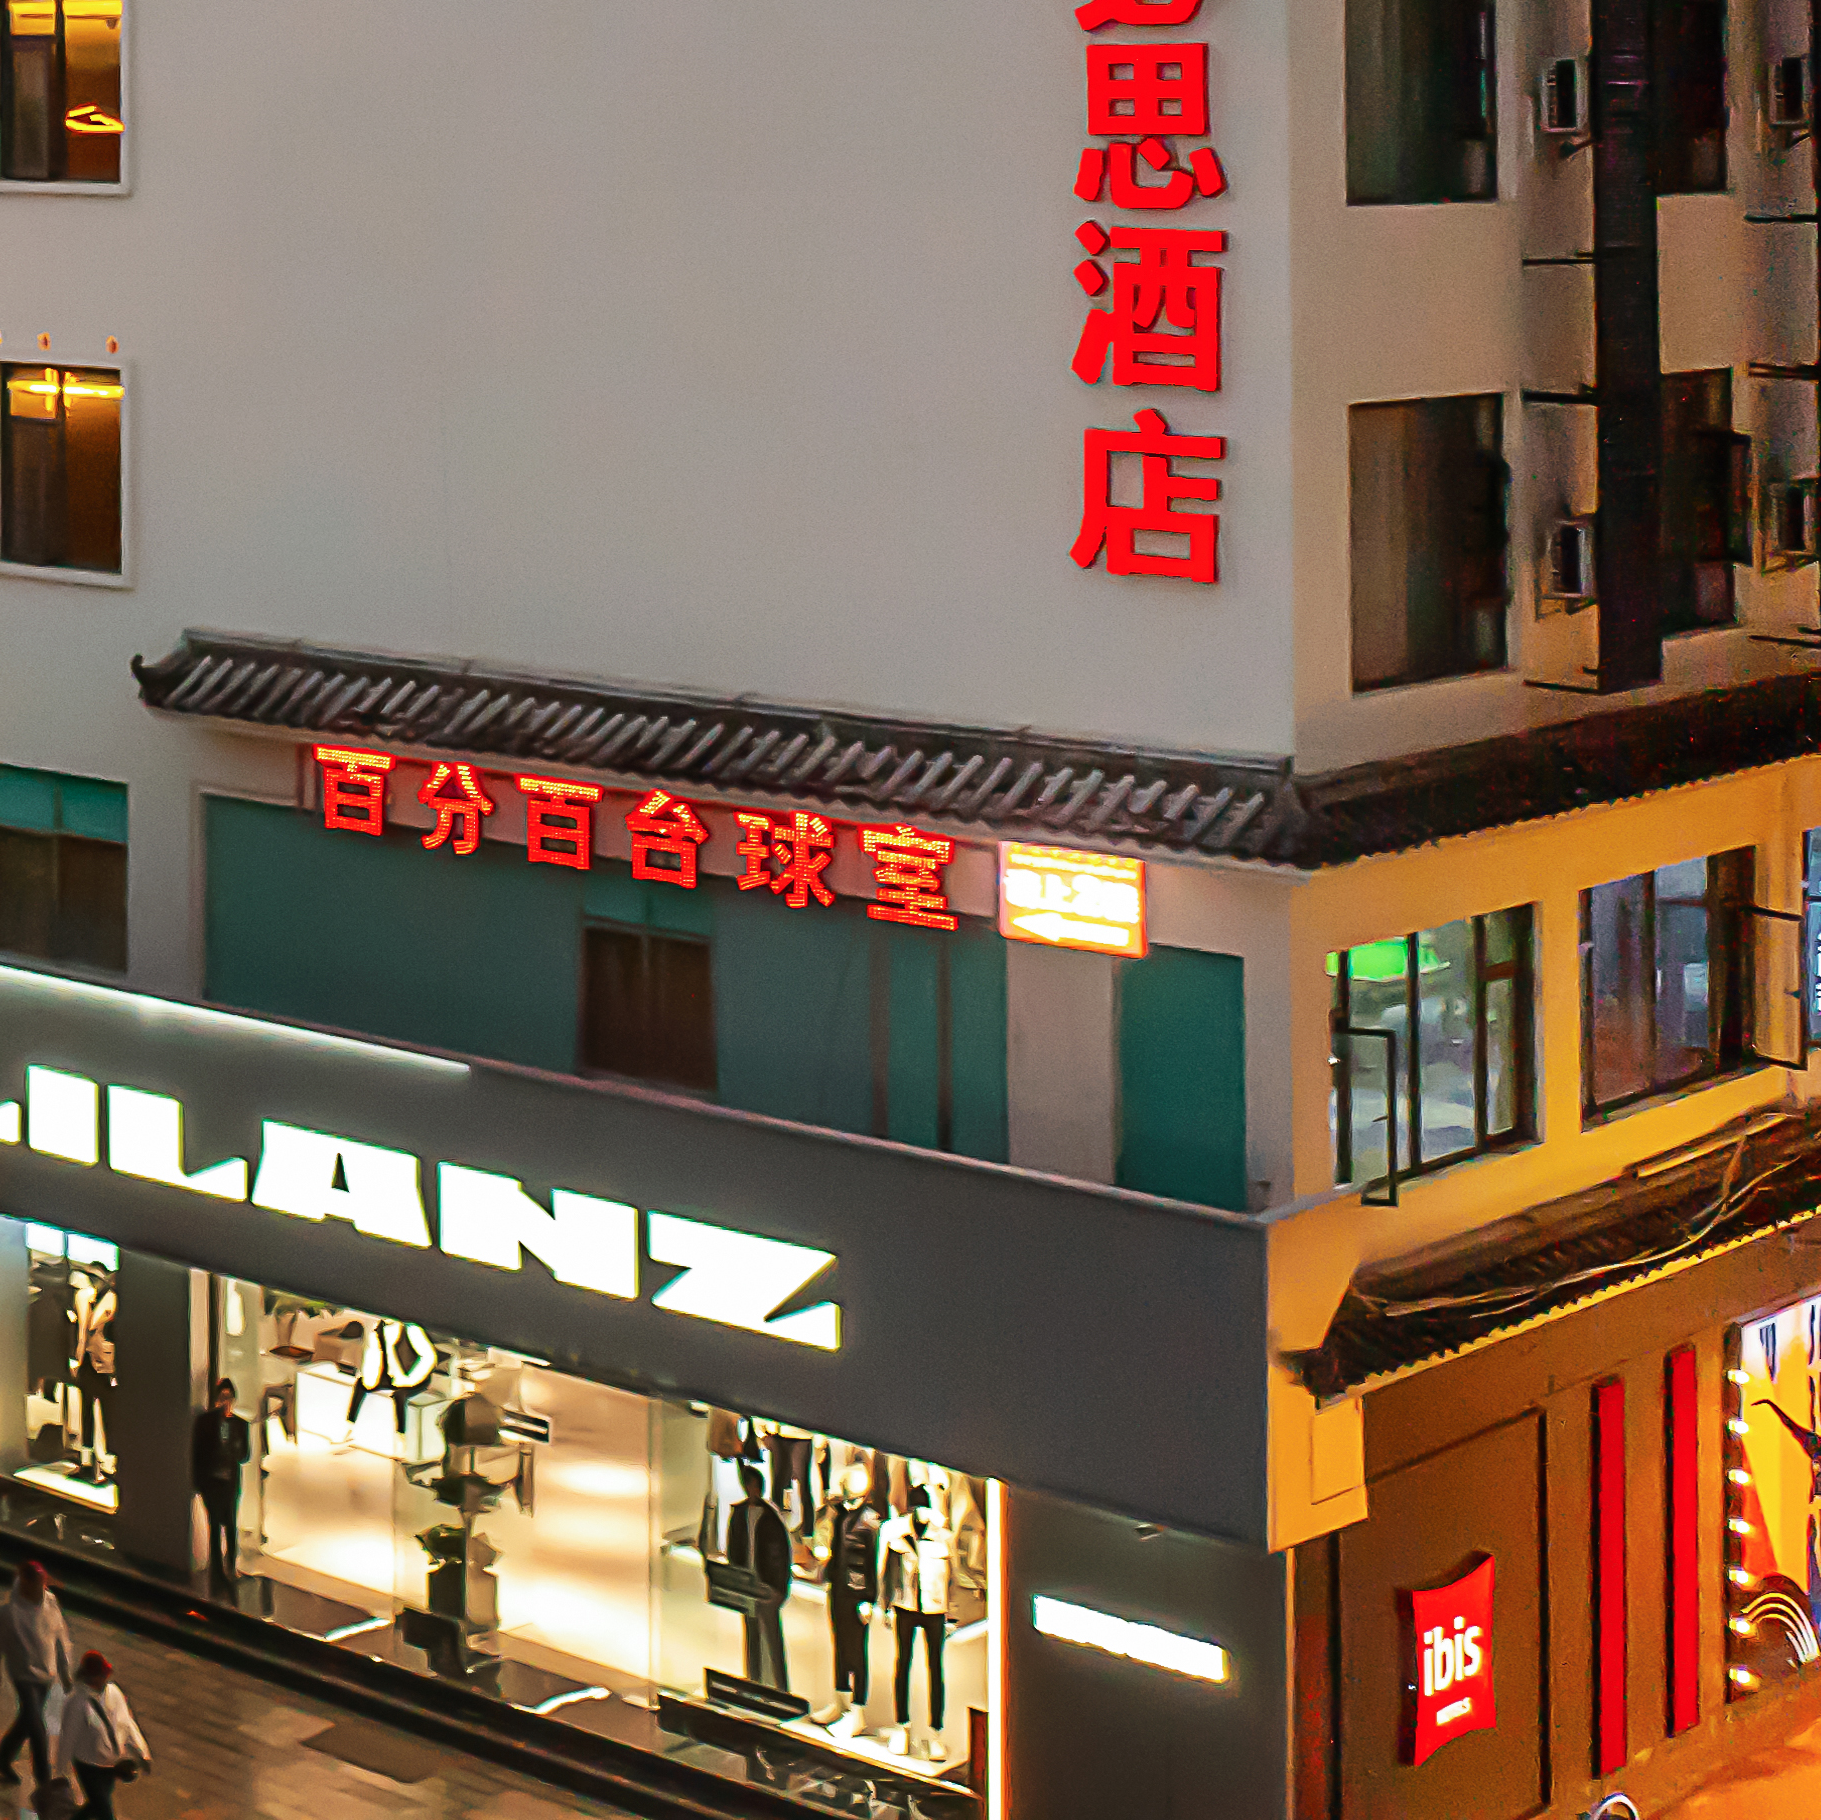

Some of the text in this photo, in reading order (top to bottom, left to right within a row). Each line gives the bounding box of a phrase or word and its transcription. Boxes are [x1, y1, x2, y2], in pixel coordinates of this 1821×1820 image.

[313, 743, 959, 932] 百分百台球室
[1423, 1616, 1483, 1697] ibis
